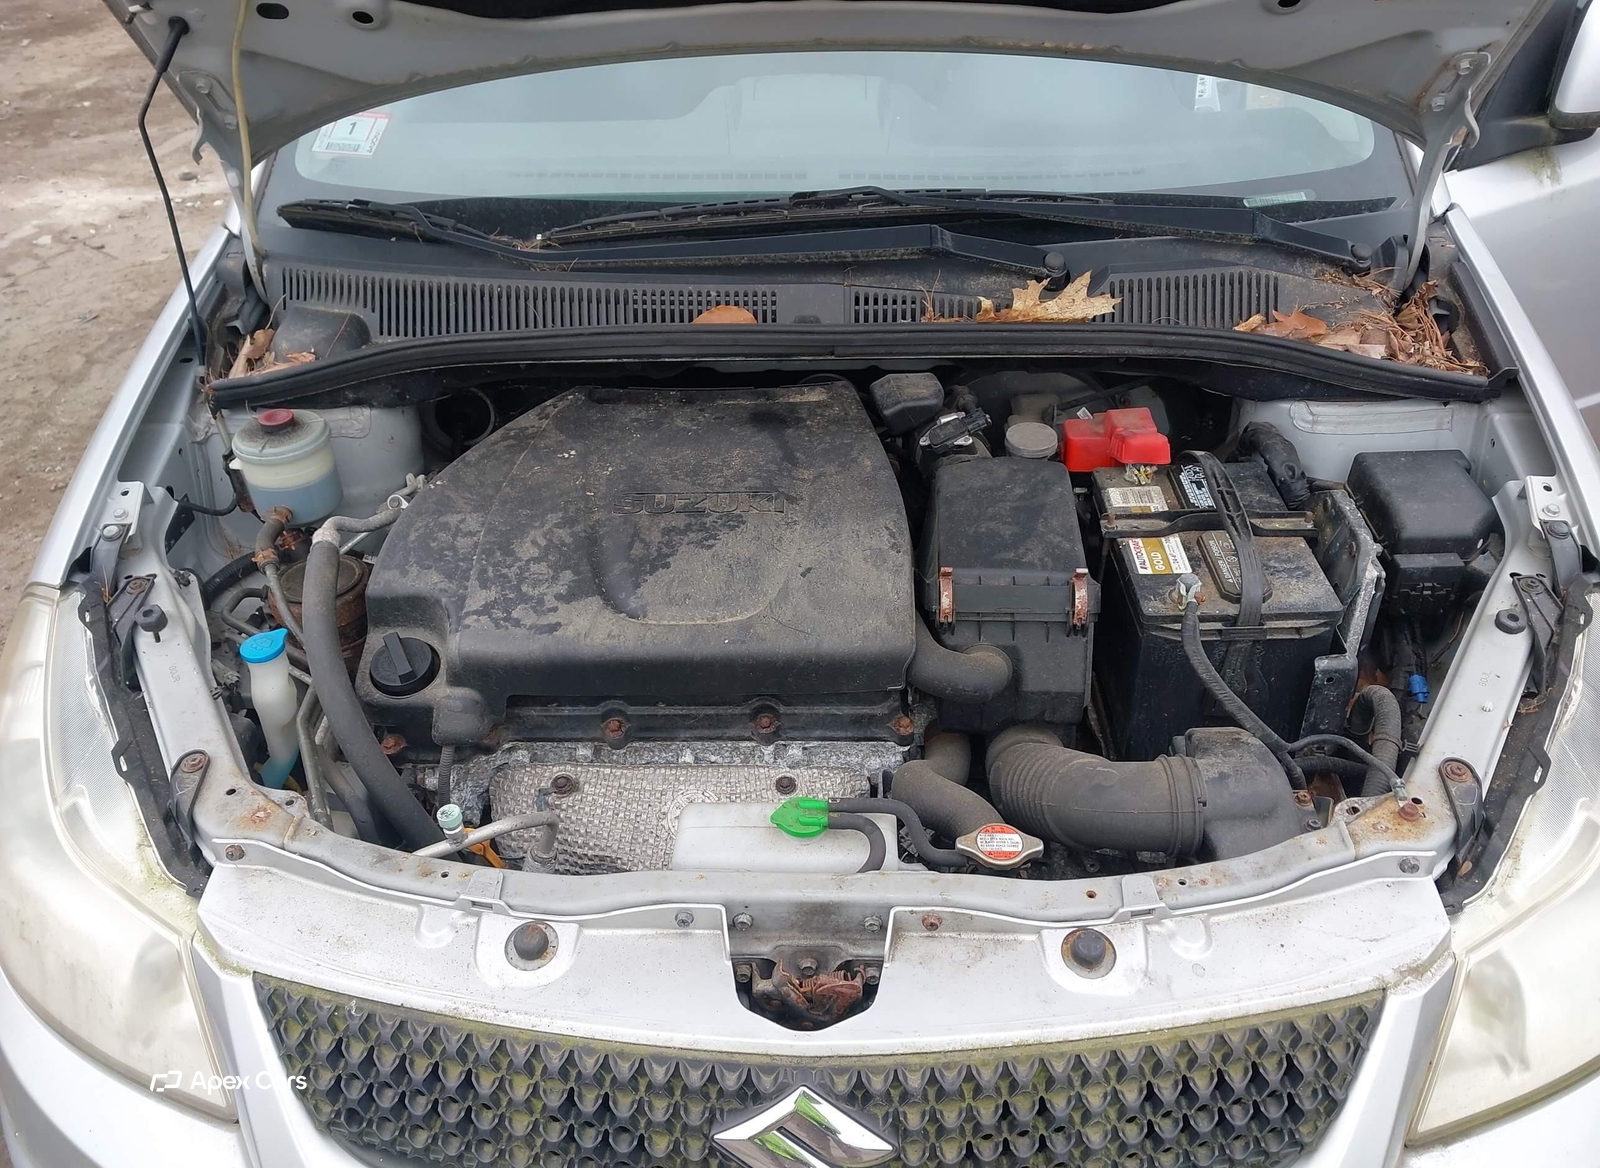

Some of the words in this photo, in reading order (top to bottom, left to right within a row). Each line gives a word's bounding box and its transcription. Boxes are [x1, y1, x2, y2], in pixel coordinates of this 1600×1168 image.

[349, 121, 357, 135] 1
[613, 492, 785, 515] SUZUKI
[1131, 539, 1147, 567] AUTOCRAF
[1151, 551, 1166, 571] GOLD
